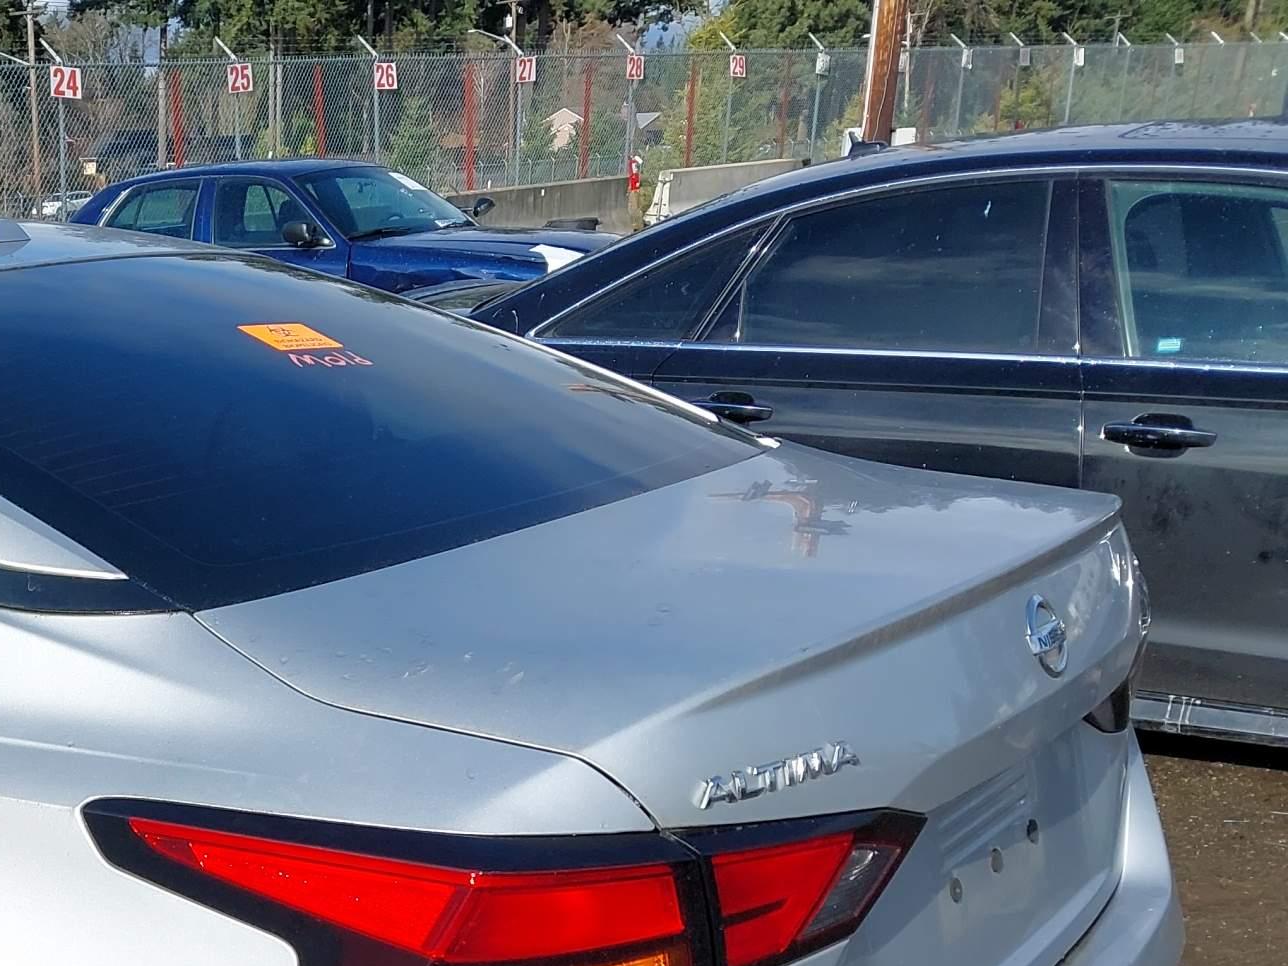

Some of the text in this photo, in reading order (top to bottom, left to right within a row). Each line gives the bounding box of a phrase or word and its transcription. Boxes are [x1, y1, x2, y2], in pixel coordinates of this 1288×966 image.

[376, 64, 394, 87] 26
[519, 59, 533, 80] 27
[629, 57, 641, 77] 28
[732, 57, 744, 75] 29
[54, 69, 79, 97] 24
[230, 65, 250, 91] 25
[696, 740, 860, 810] ALTIMA
